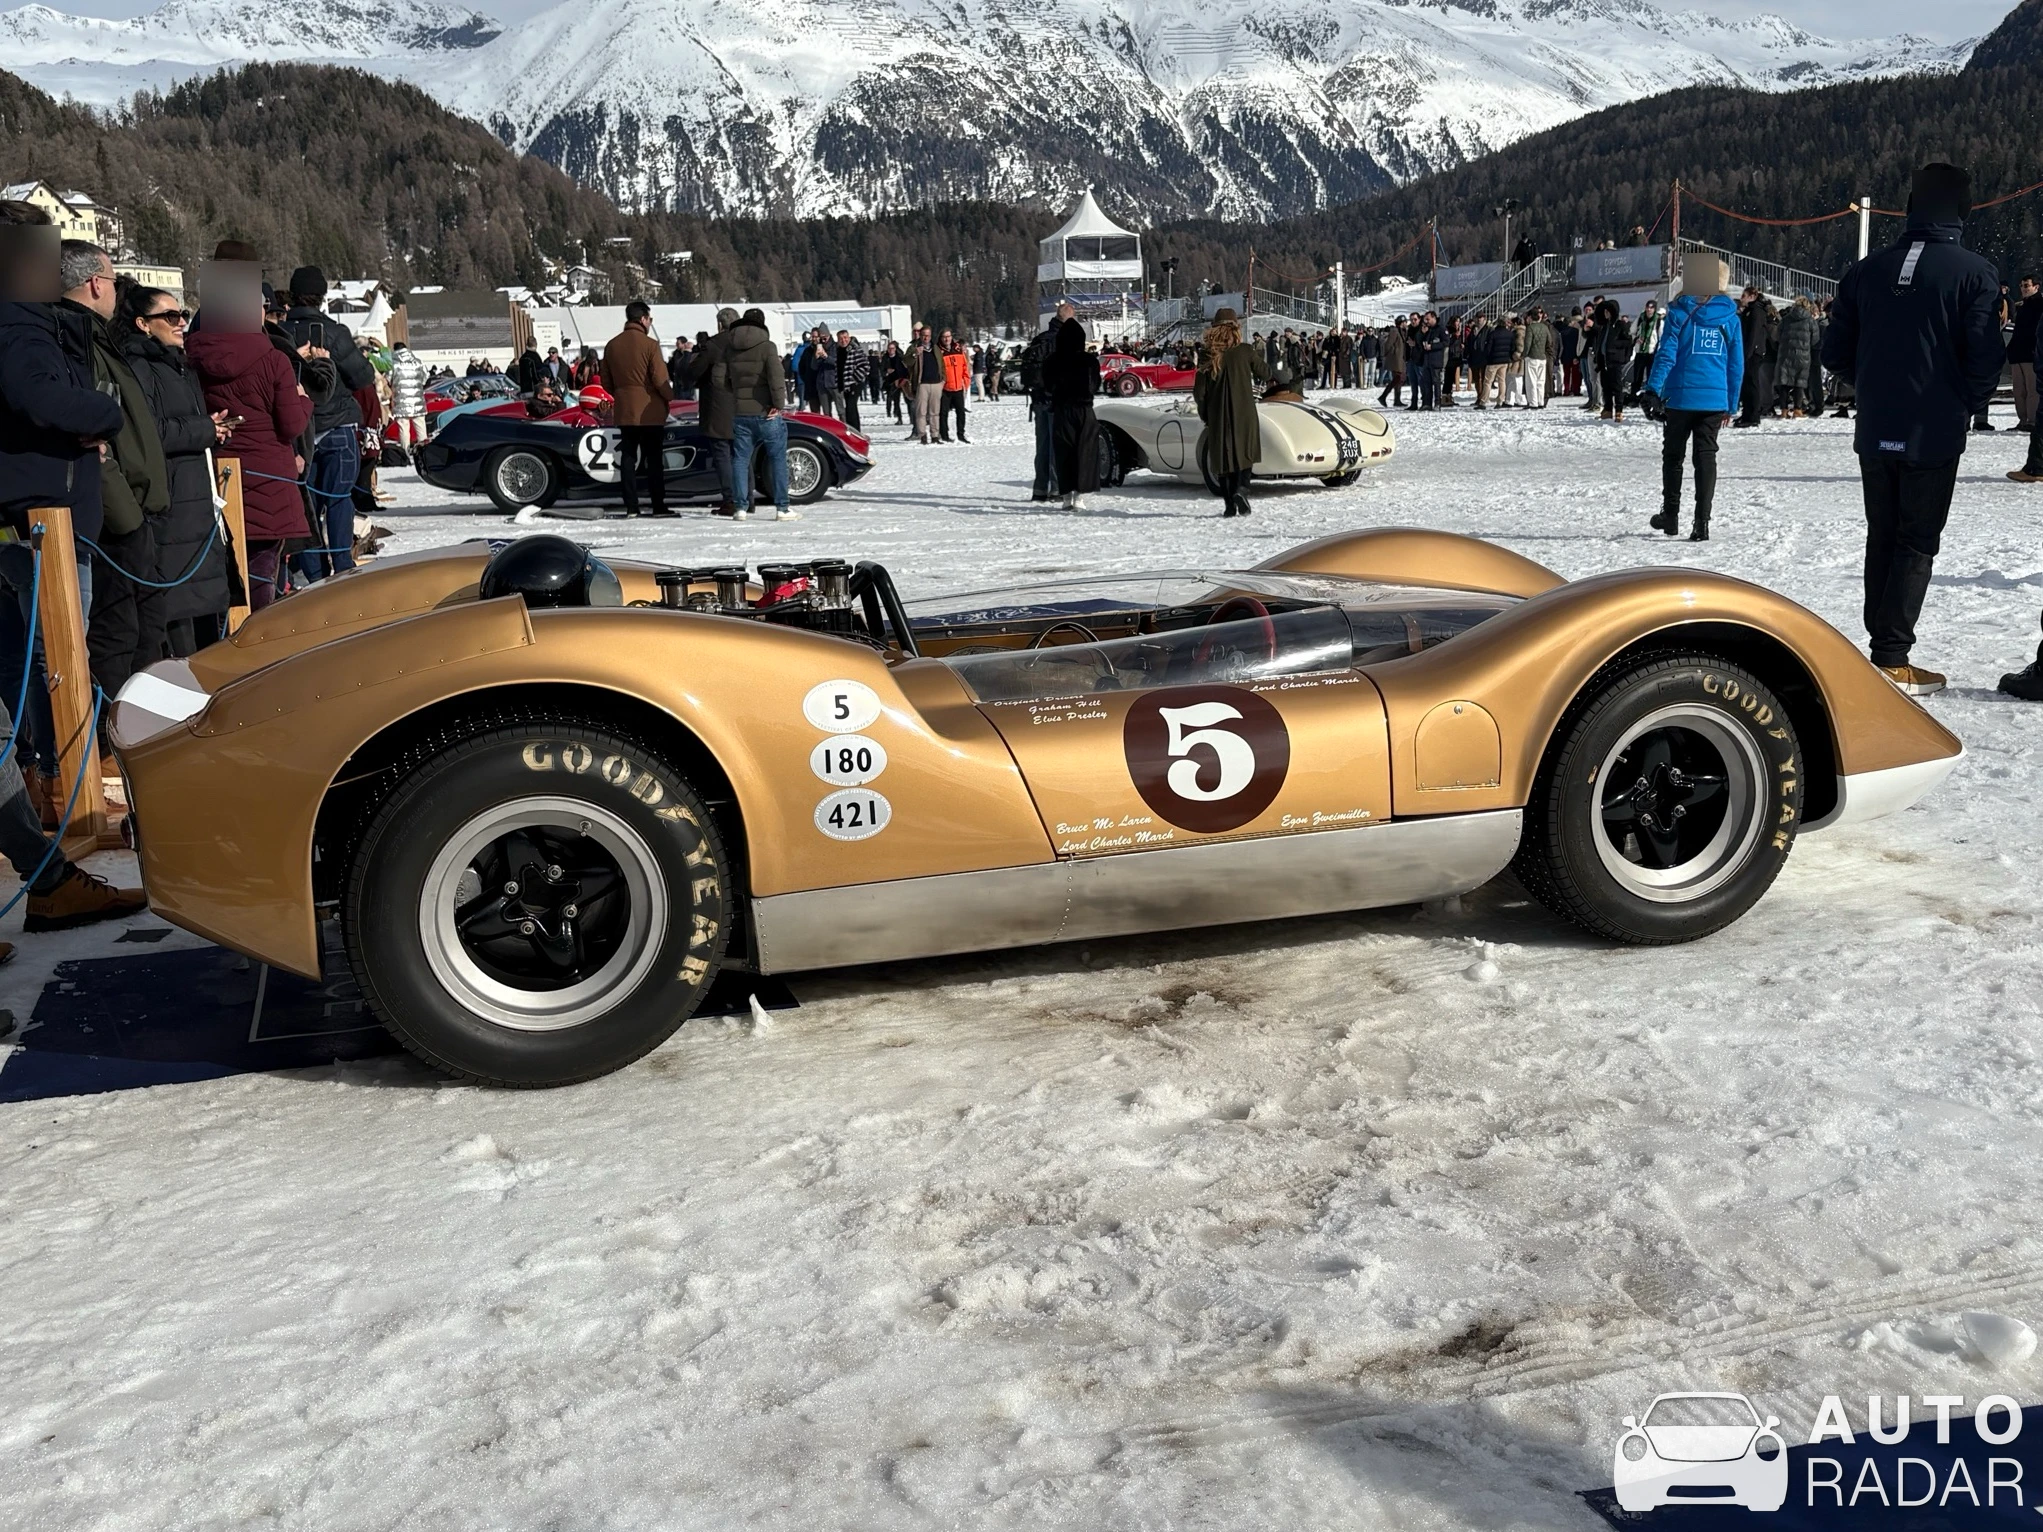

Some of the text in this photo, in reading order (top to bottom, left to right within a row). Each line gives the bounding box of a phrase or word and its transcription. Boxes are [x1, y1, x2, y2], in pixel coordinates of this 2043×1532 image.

[1573, 237, 1583, 248] A2
[1700, 328, 1719, 339] THE
[1700, 339, 1718, 349] ICE
[1341, 440, 1358, 450] 248
[1342, 449, 1359, 459] XUX
[1250, 677, 1360, 692] Lord Charlie March
[834, 695, 850, 720] 5
[994, 698, 1040, 707] Original
[1028, 700, 1102, 714] Graham Hill
[1033, 711, 1108, 725] Elvis Presley
[1159, 702, 1256, 802] 5
[825, 747, 872, 774] 180
[828, 800, 877, 829] 421
[1280, 808, 1371, 828] Egon Zweimüller
[1056, 814, 1153, 834] Bruce Mc Laren
[1058, 828, 1175, 852] Lord Charles March
